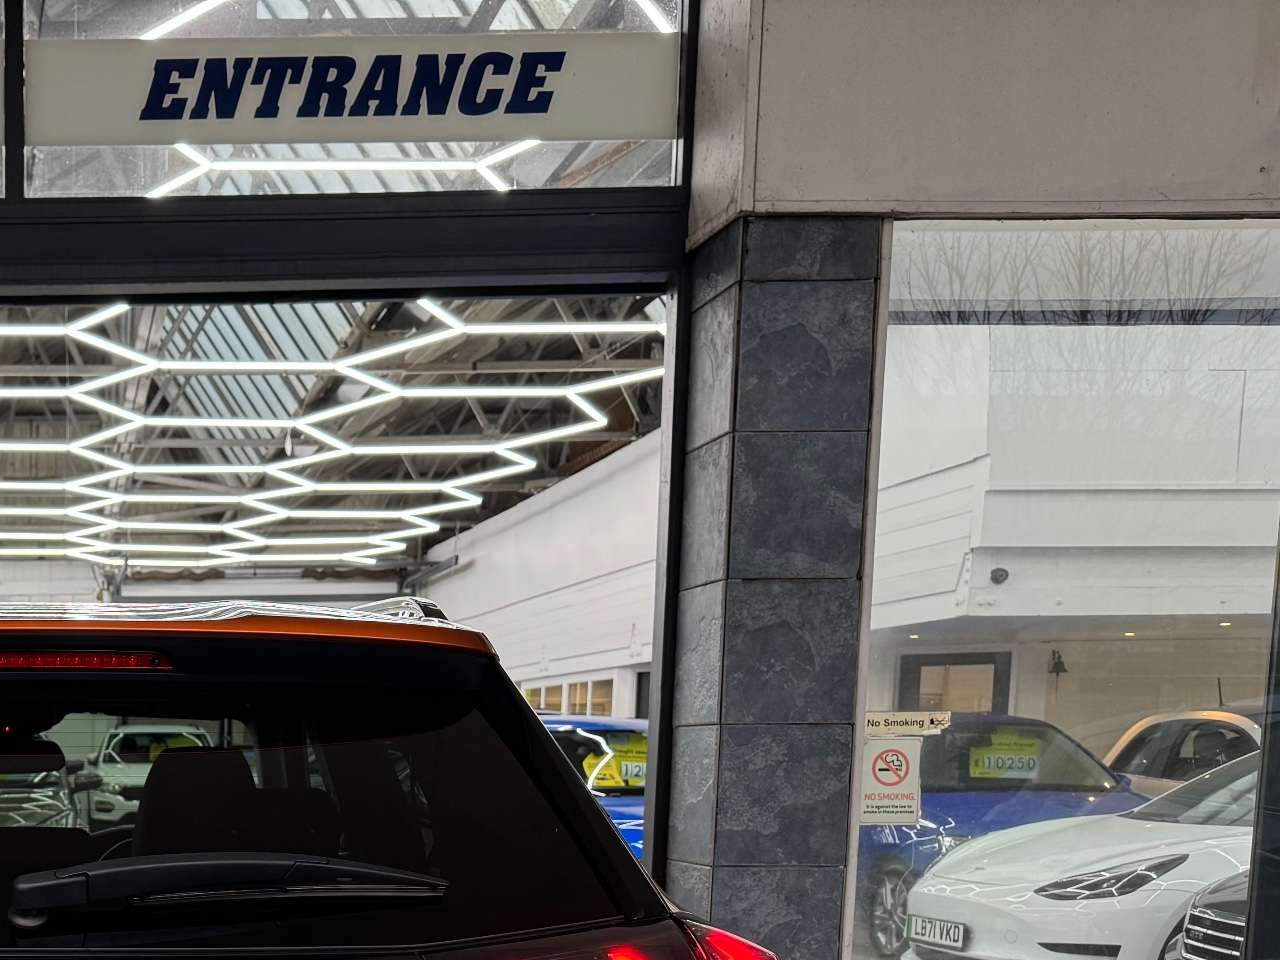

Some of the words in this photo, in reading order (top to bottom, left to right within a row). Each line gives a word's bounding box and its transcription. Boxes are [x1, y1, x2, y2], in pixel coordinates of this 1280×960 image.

[139, 50, 567, 121] ENTRANCE
[867, 719, 881, 727] No
[884, 718, 924, 728] Smoking
[864, 792, 876, 801] NO
[914, 918, 937, 940] LB71
[939, 921, 960, 943] VKD
